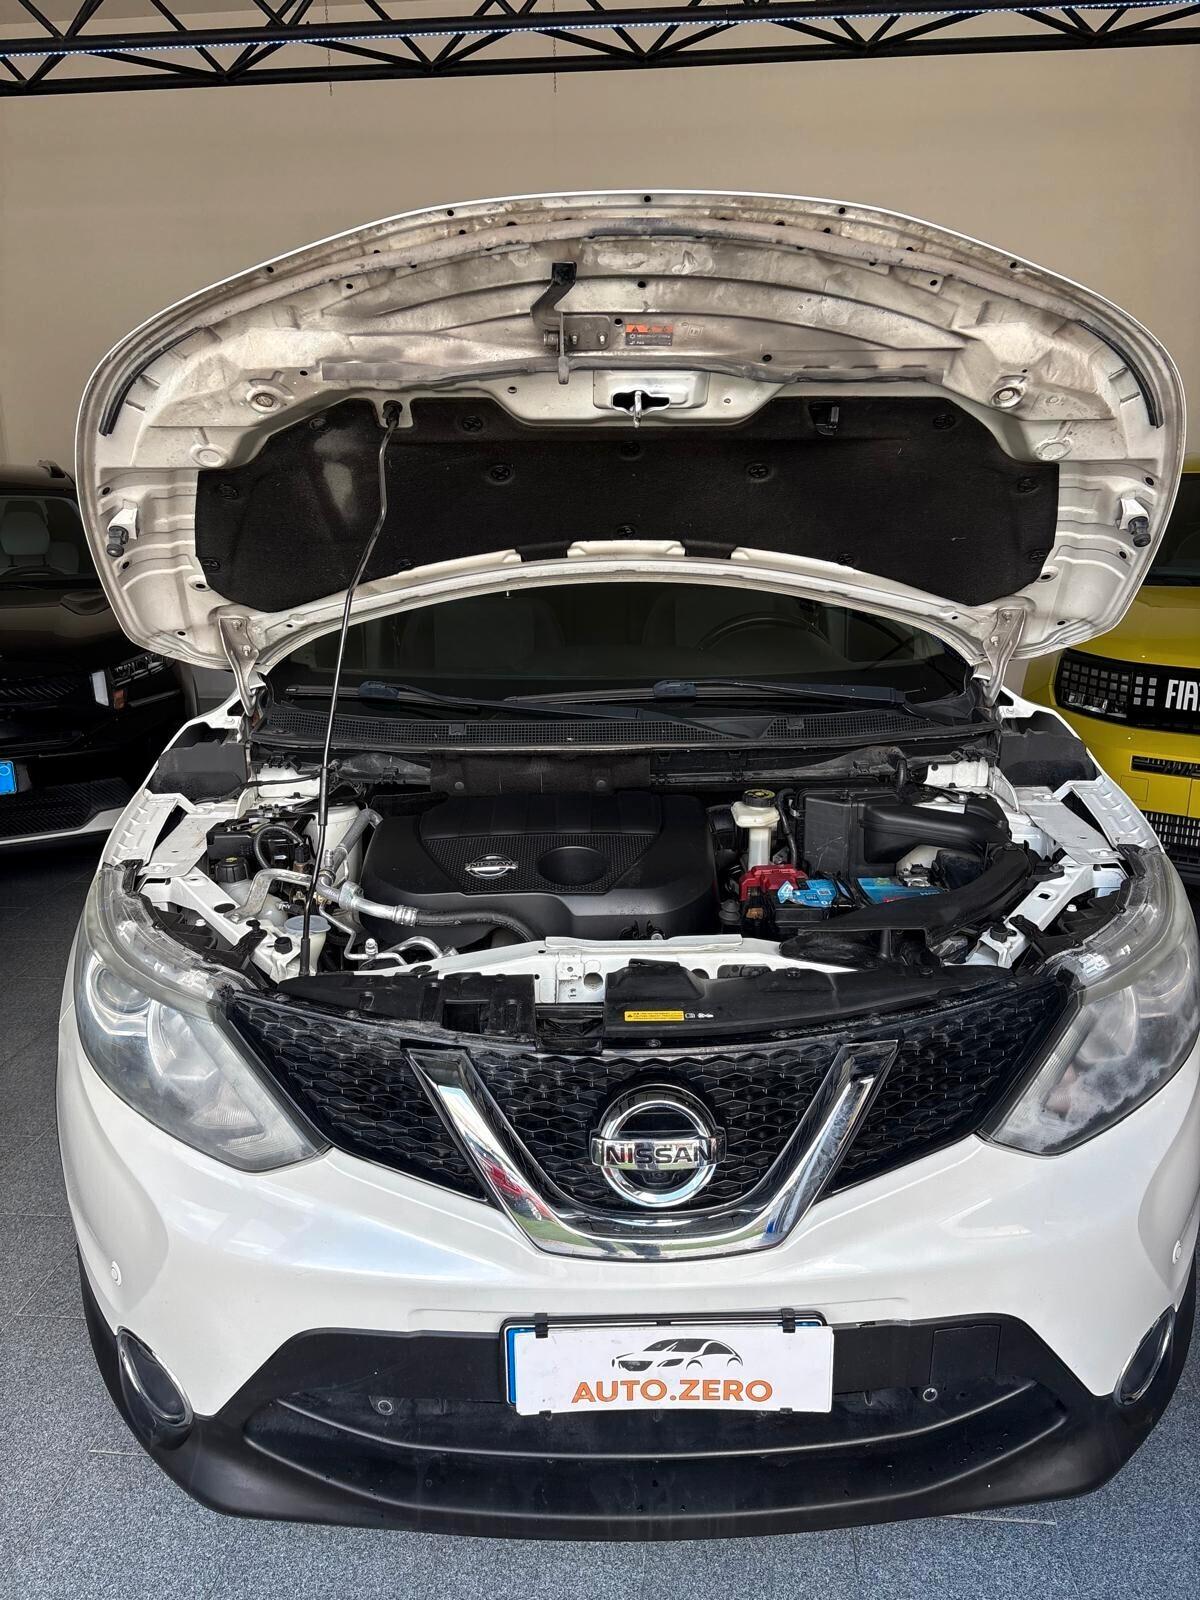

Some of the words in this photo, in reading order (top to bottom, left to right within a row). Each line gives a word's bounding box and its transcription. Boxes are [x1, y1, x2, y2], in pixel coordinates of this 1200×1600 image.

[1165, 679, 1200, 712] FIA
[605, 1146, 712, 1164] NISSAN
[571, 1379, 773, 1403] AUTO.ZERO
